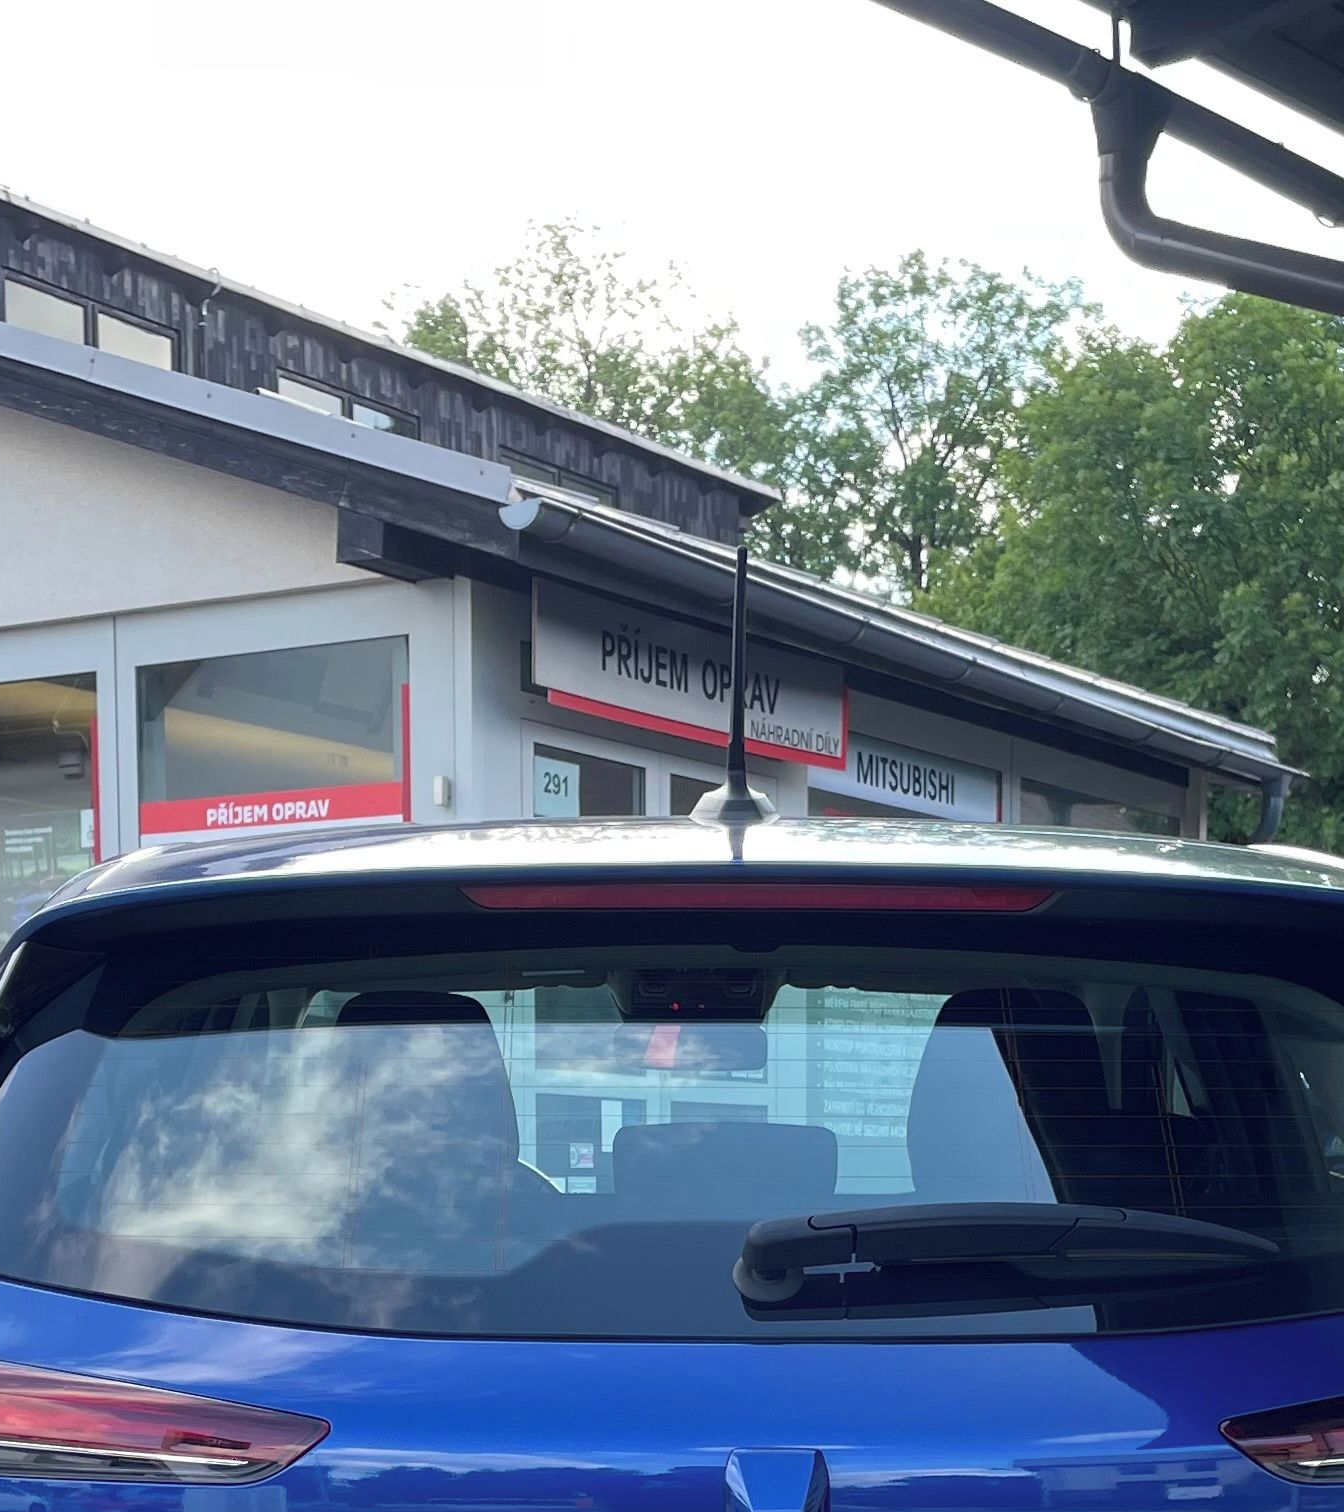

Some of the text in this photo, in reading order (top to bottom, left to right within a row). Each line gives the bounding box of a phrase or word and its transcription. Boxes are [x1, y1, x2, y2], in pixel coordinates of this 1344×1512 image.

[601, 623, 689, 694] PŘÍJEM
[750, 718, 841, 756] NÁHRADNÍ DÍLY
[543, 772, 569, 797] 291
[856, 751, 955, 806] MITSUBISHI
[206, 799, 330, 826] PŘÍJEM OPRAV
